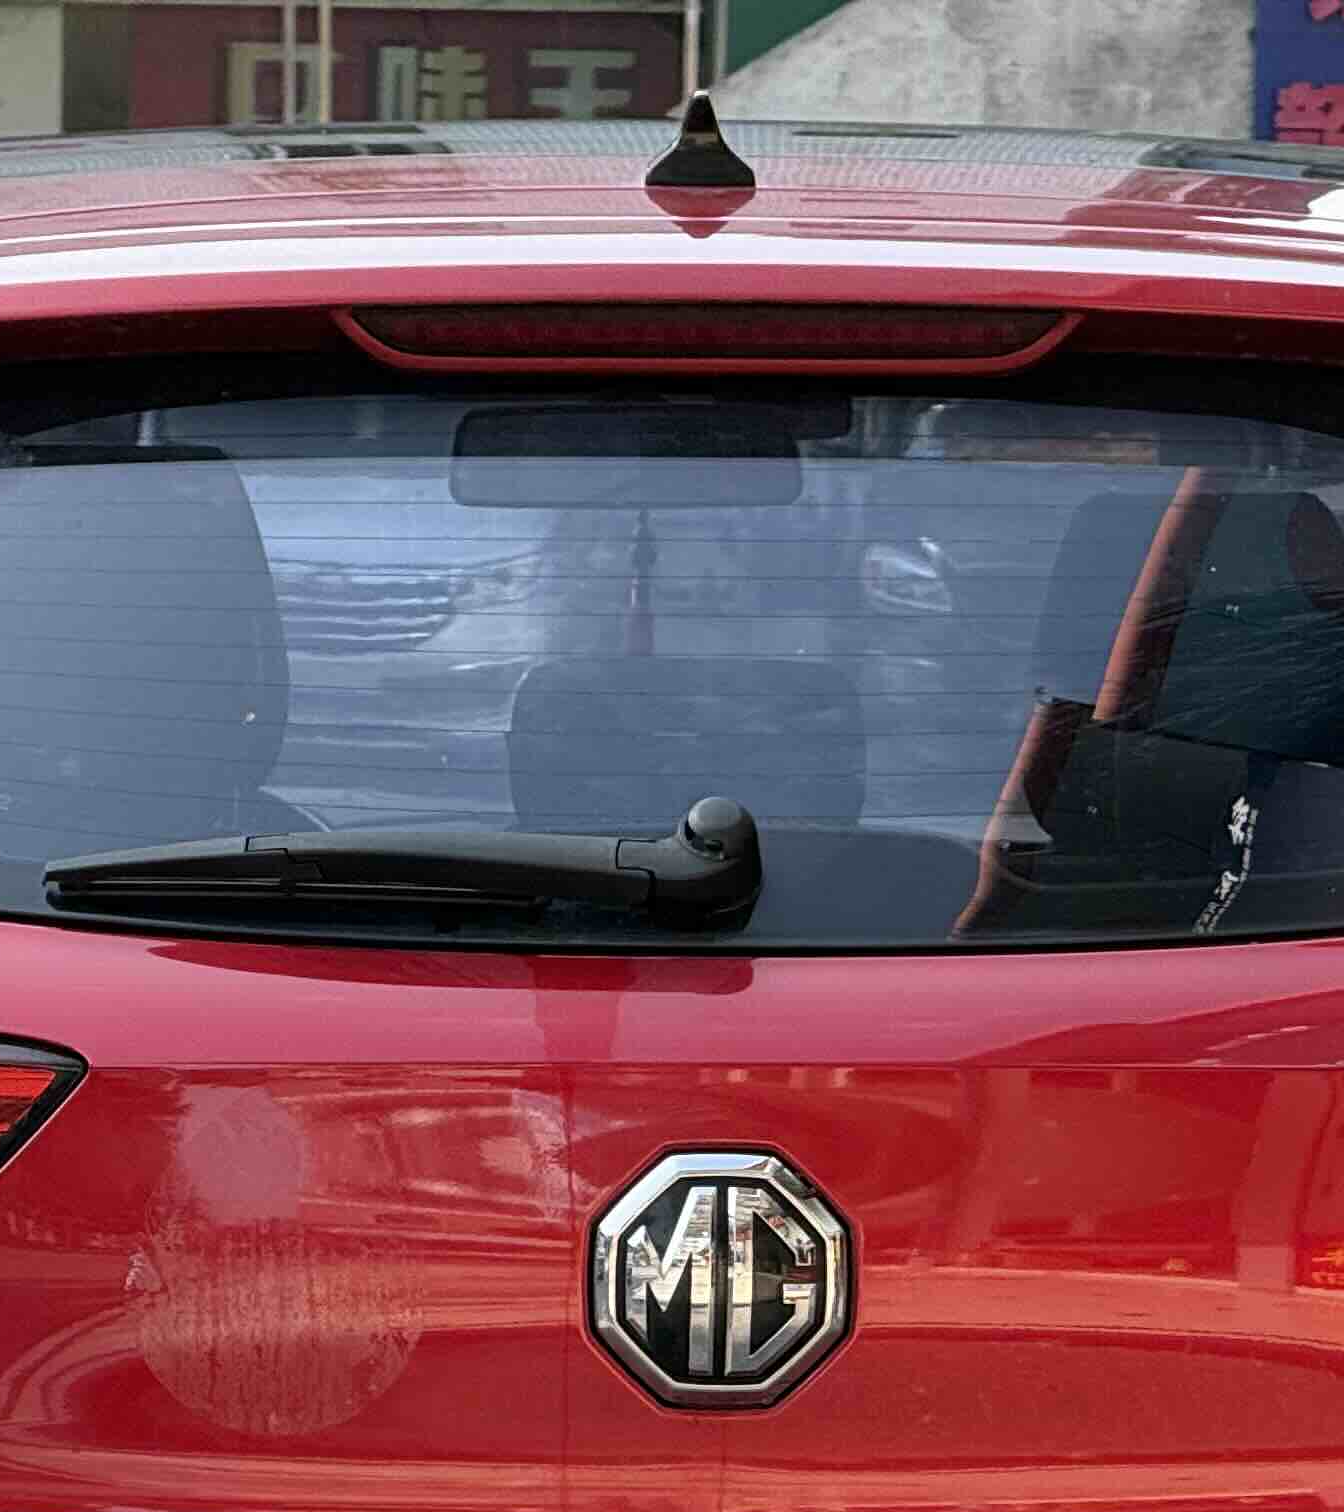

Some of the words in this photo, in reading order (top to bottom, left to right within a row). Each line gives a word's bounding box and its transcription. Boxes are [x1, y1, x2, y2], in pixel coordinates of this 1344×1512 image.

[227, 42, 636, 121] 口味王
[625, 1185, 817, 1377] MG
